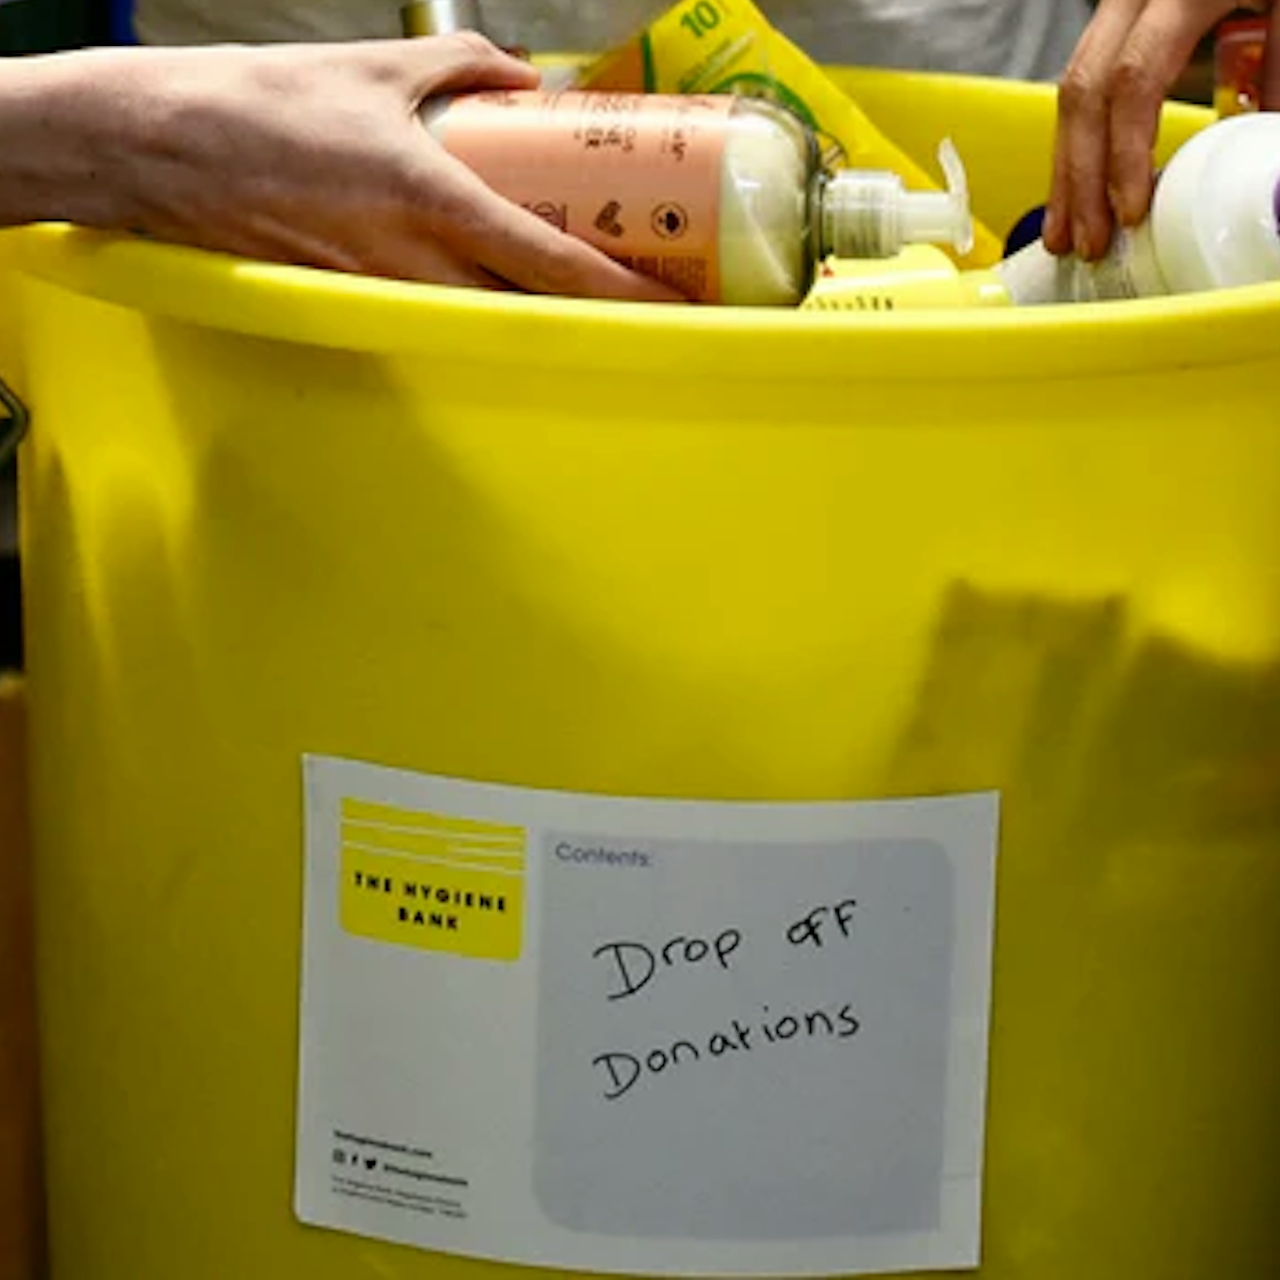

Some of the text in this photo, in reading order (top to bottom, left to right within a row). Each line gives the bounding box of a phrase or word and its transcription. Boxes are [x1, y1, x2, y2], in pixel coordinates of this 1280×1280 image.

[679, 0, 721, 38] 10
[353, 870, 507, 913] THE HYGIENE
[397, 906, 460, 931] BANK
[591, 927, 742, 1002] Drop
[591, 1004, 861, 1101] Donations
